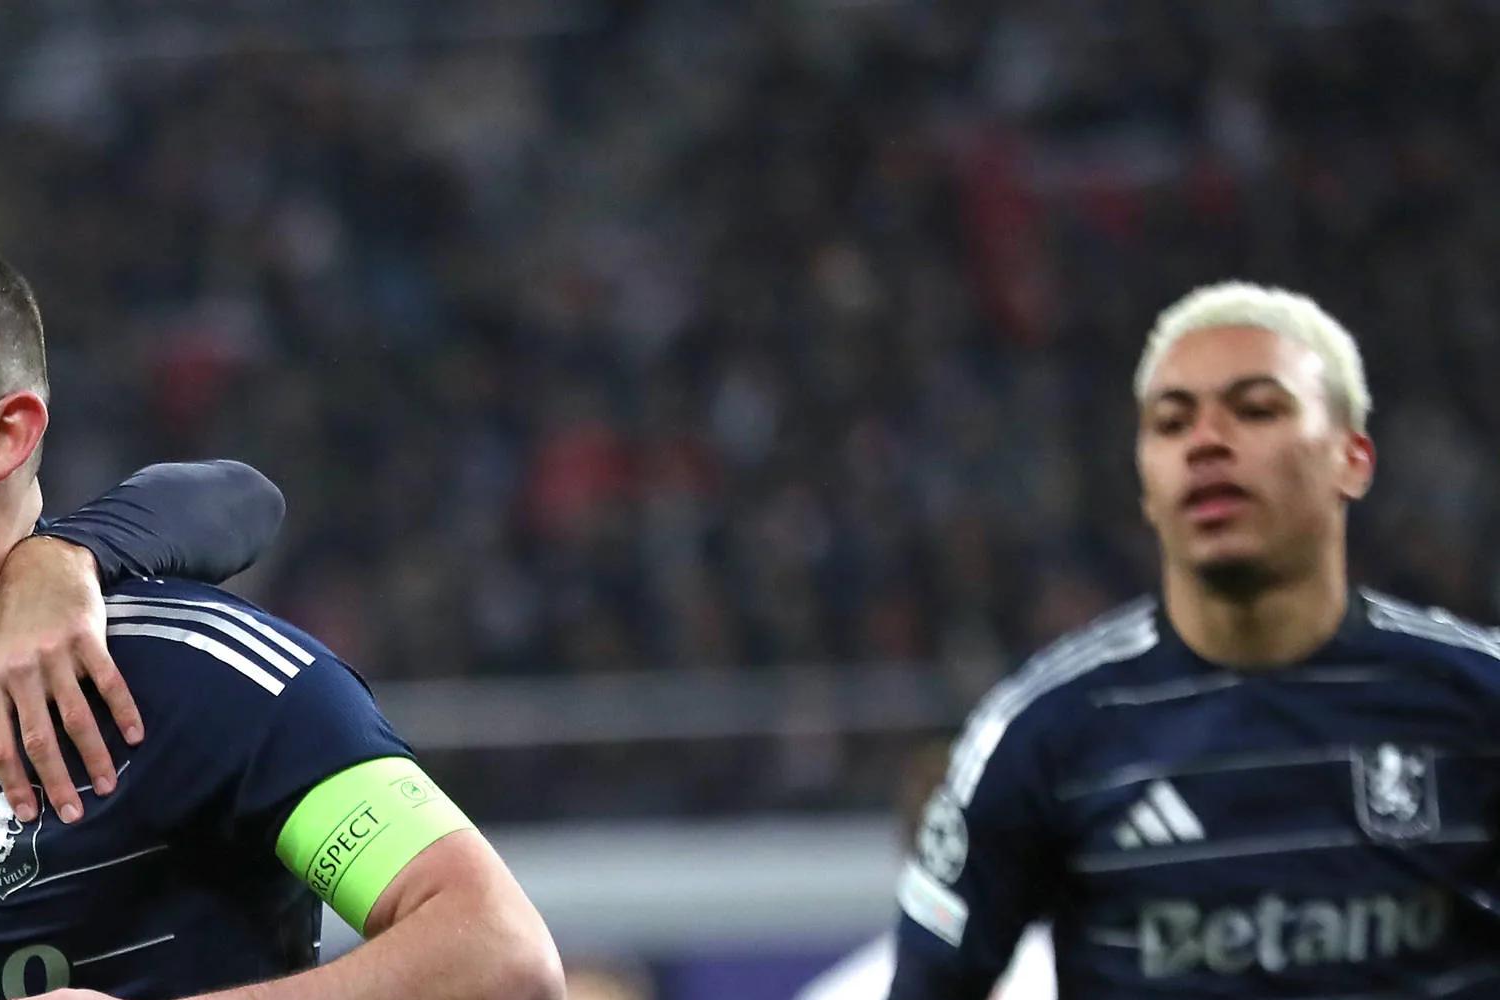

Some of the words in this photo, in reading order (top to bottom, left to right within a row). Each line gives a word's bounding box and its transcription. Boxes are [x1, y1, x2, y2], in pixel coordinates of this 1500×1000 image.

[3, 863, 32, 885] VILLA
[311, 806, 379, 897] RESPECT
[1138, 893, 1448, 980] Betano
